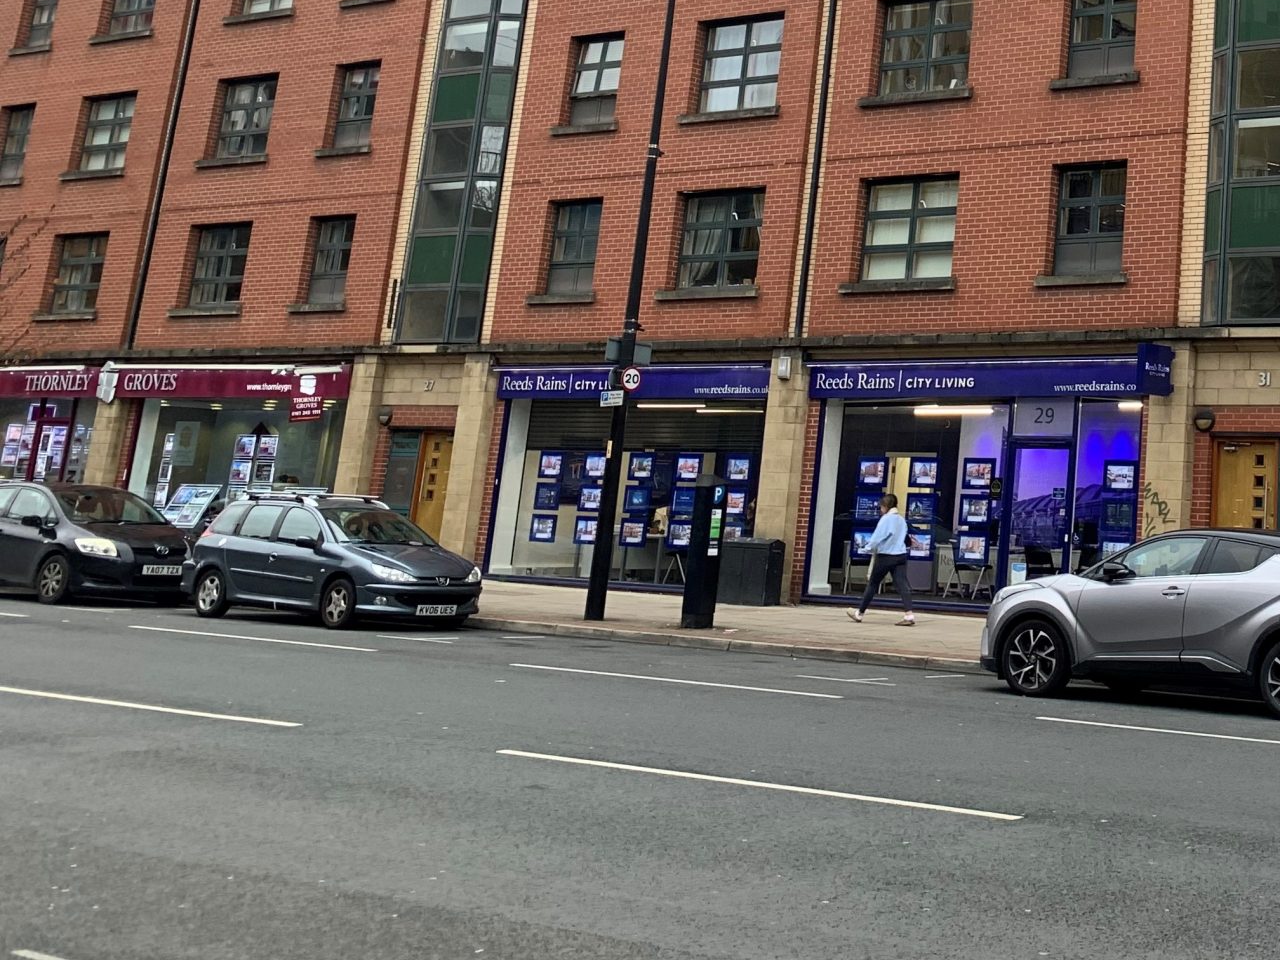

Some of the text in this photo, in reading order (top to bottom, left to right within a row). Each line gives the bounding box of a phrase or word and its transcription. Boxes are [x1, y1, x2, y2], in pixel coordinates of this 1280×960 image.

[25, 373, 178, 391] THORNLEY GROVES
[424, 380, 435, 392] 27
[502, 376, 533, 391] Reeds
[536, 375, 567, 390] Rains
[575, 380, 597, 390] CITY
[625, 374, 639, 384] 20
[816, 373, 975, 389] Reeds Rains CITY LIVING
[1258, 372, 1271, 386] 31
[694, 385, 769, 394] www.reedsrains.co.uk
[1054, 381, 1137, 392] www.reedsrains.co
[1034, 407, 1055, 424] 29
[714, 487, 722, 501] P
